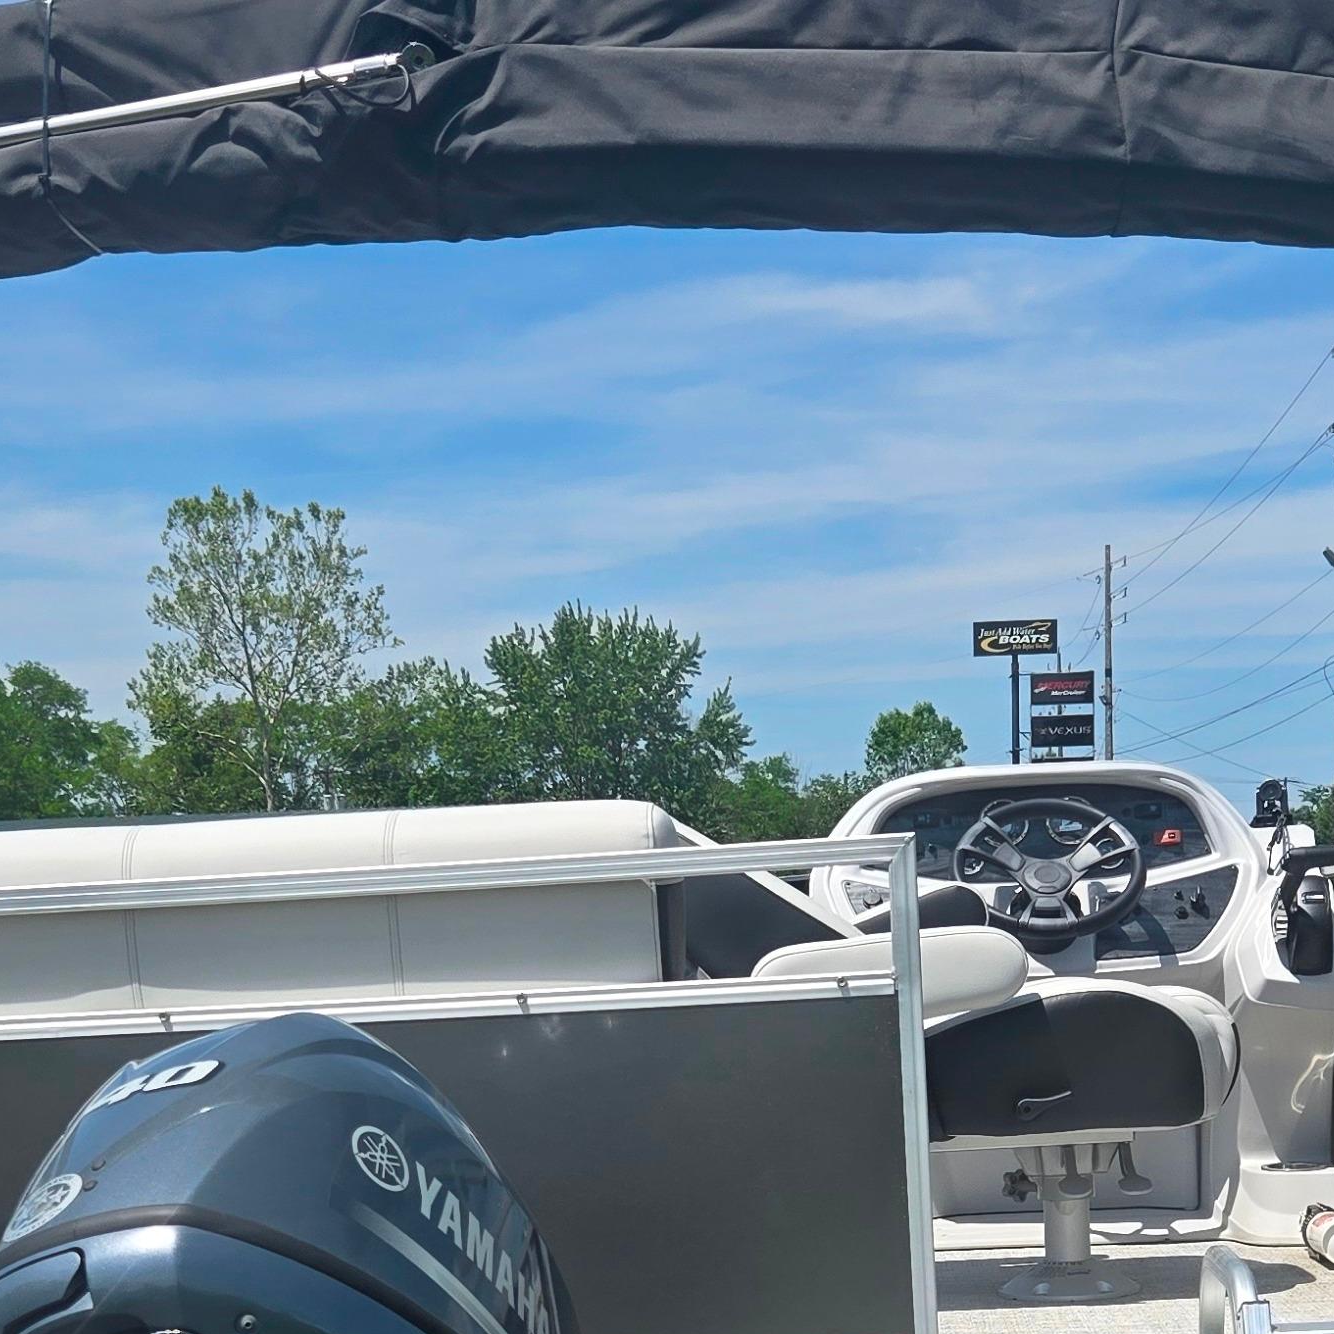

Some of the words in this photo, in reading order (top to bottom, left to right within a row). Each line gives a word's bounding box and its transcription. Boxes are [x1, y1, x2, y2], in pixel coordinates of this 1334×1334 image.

[978, 628, 995, 639] Just
[996, 627, 1011, 636] Add
[1012, 627, 1035, 636] Water
[999, 634, 1050, 644] BOATS
[1048, 725, 1092, 735] VEXUS
